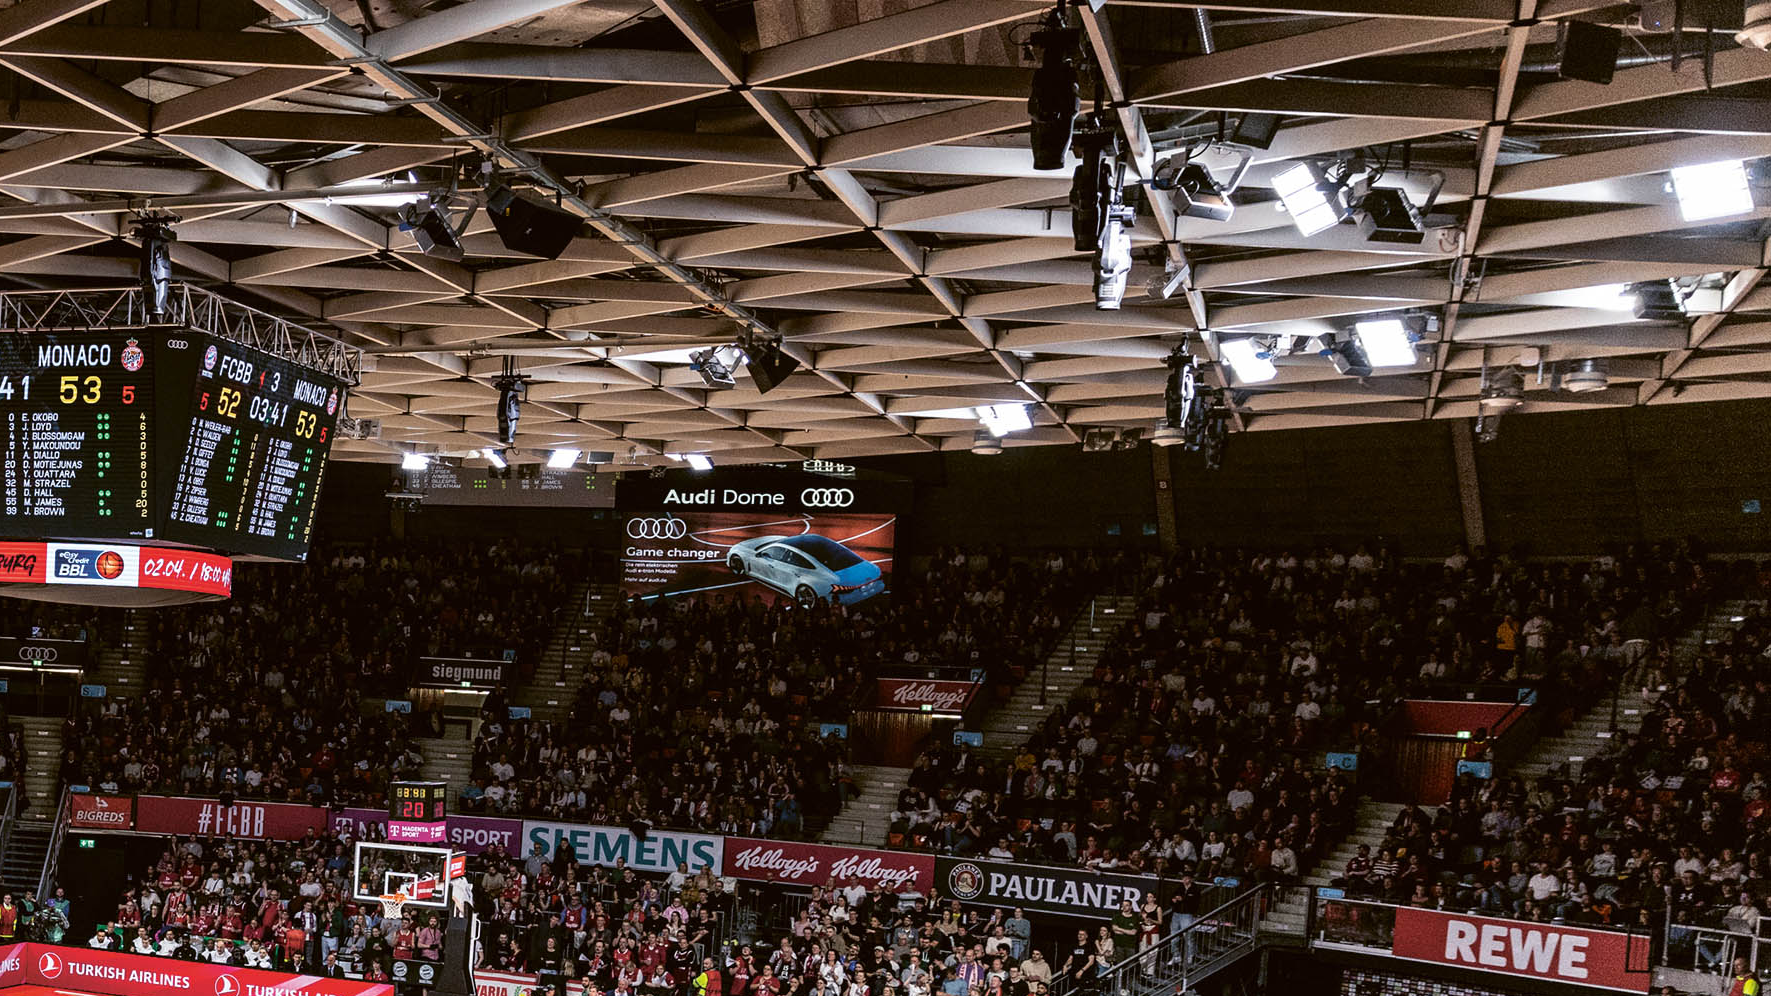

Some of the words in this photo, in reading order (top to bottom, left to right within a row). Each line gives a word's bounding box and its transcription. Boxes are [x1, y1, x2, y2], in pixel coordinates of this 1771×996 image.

[38, 344, 111, 367] MONACO
[220, 355, 253, 384] FCBB
[271, 372, 280, 392] 3
[293, 379, 327, 407] MONACO
[60, 376, 102, 404] 53
[122, 386, 135, 404] 5
[9, 413, 14, 421] 0
[32, 413, 58, 421] OKOBO
[200, 392, 210, 411] 5
[218, 387, 241, 419] 52
[250, 396, 288, 428] 03:41
[295, 410, 316, 439] 53
[320, 427, 328, 443] 5
[32, 423, 52, 431] LOYD
[32, 432, 84, 440] BLOSSOMGAM
[33, 442, 80, 450] MAKOUNDOU
[34, 470, 76, 478] OUATTARA
[35, 480, 71, 488] STRAZEL
[34, 489, 53, 497] HALL
[664, 489, 715, 505] Audi
[724, 490, 784, 505] Dome
[34, 508, 64, 516] BROWN
[626, 547, 663, 556] Game
[668, 548, 720, 559] changer
[59, 564, 88, 576] BBL
[144, 558, 185, 577] 02.04.
[432, 664, 501, 681] siegmund
[894, 682, 967, 708] Kellogg's
[76, 810, 124, 823] BIGREDS
[404, 802, 423, 817] 20
[198, 804, 264, 837] #FCBB
[452, 827, 512, 847] SPORT
[735, 846, 819, 879] Kellogg's
[831, 854, 921, 887] Kellogg's
[988, 872, 1141, 912] PAULANER
[1444, 919, 1589, 978] REWE
[67, 962, 126, 981] TURKISH
[129, 970, 190, 989] AIRLINES
